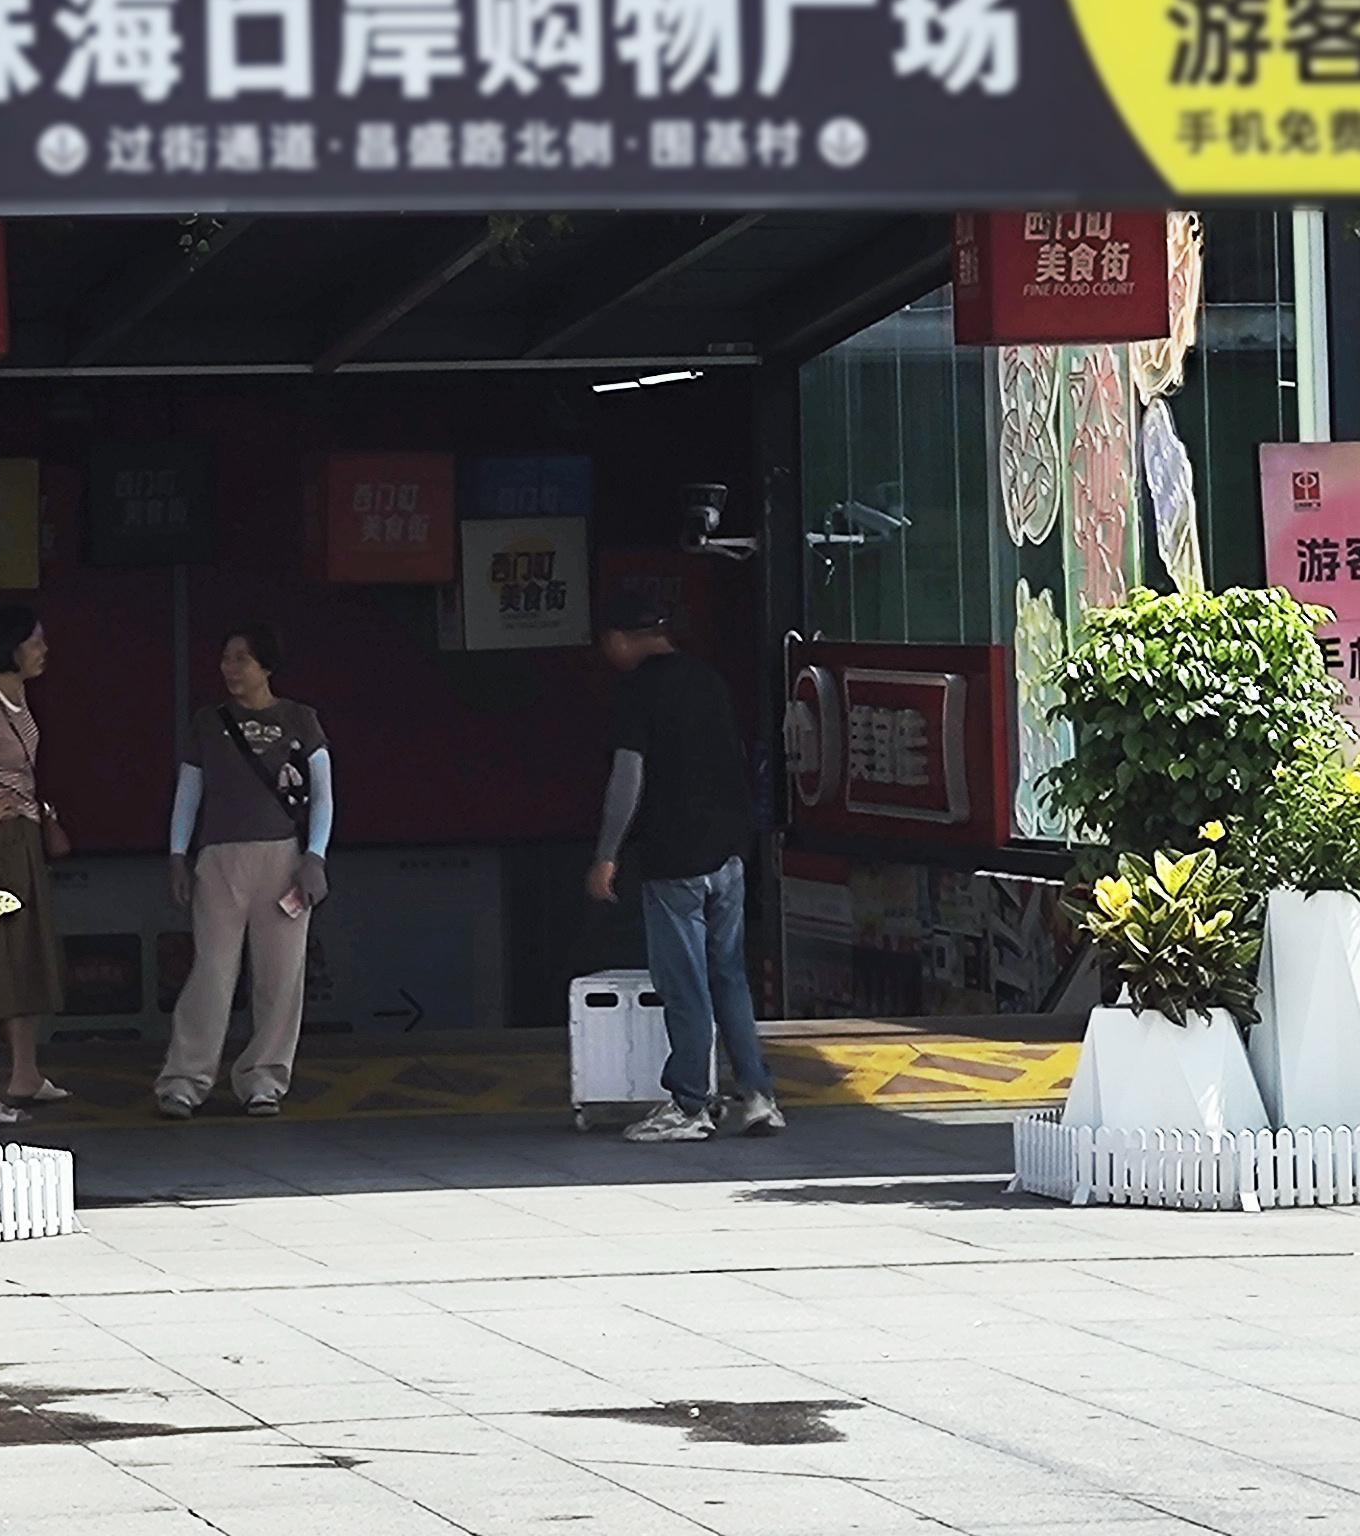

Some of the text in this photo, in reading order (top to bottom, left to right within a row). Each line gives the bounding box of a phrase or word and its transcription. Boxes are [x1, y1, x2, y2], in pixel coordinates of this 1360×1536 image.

[1035, 241, 1131, 283] 美食街
[1053, 283, 1090, 296] FOOD
[1093, 282, 1135, 295] COURT
[361, 512, 431, 544] 美食街
[492, 551, 557, 583] 西门町
[499, 581, 567, 613] 美食街
